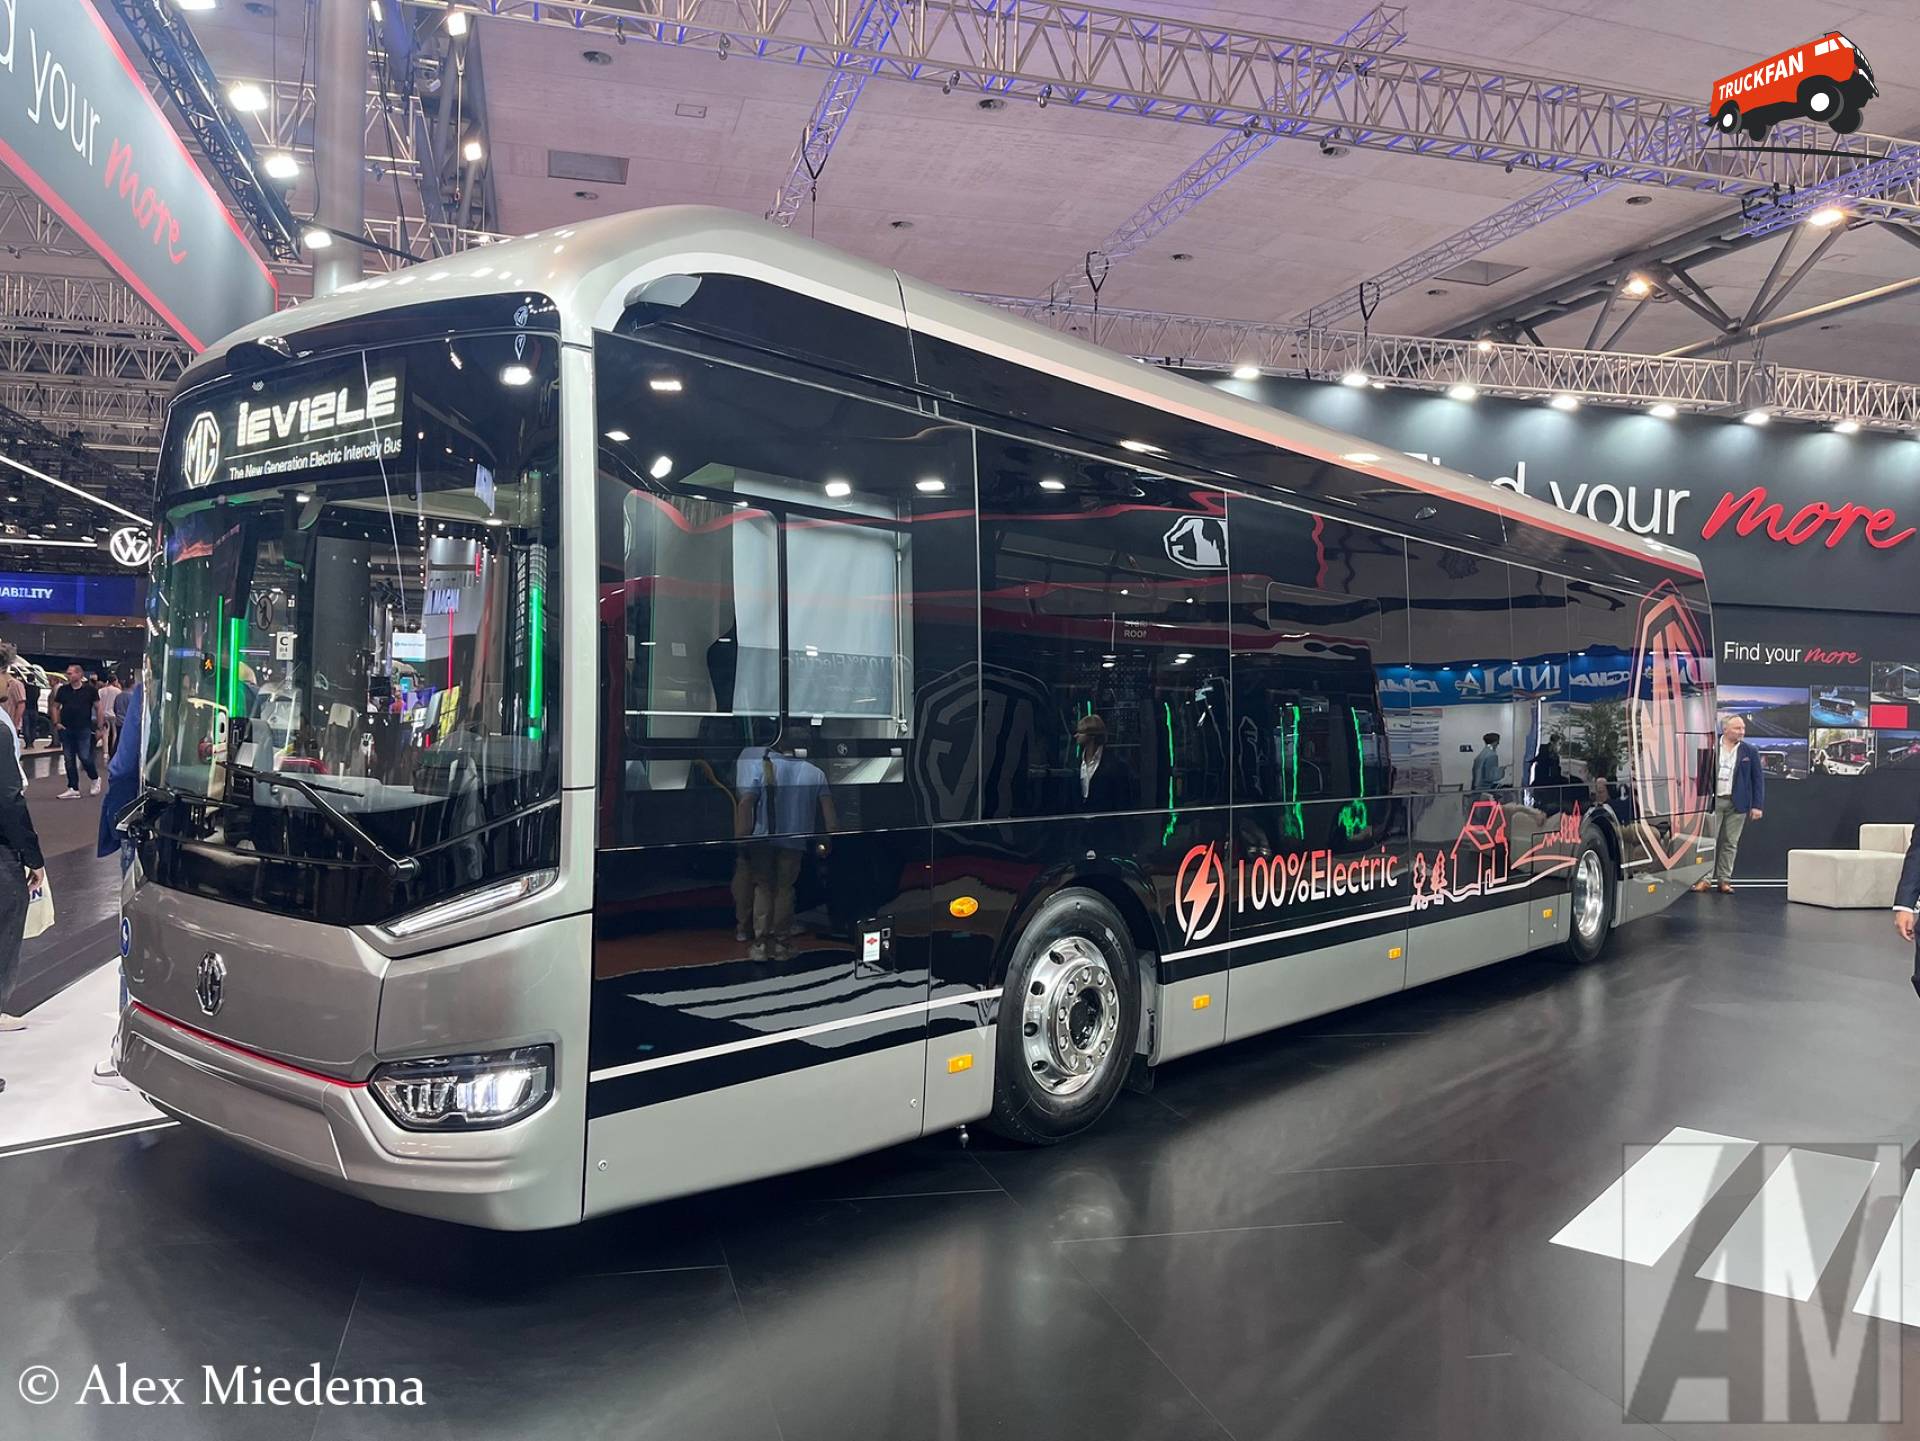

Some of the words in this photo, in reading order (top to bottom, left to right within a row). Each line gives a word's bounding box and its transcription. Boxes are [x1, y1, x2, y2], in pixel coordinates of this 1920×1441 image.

[27, 28, 101, 167] your
[104, 138, 188, 265] more
[186, 416, 219, 487] MG
[229, 467, 244, 480] The
[245, 463, 264, 477] New
[264, 455, 308, 475] Generation
[309, 447, 342, 468] Electric
[343, 440, 382, 460] Intercity
[383, 436, 402, 454] Bus
[1549, 481, 1691, 535] your
[1701, 486, 1917, 549] more
[0, 586, 53, 599] ABILITY
[1723, 641, 1760, 662] Find
[1765, 647, 1802, 665] your
[1804, 647, 1863, 664] more
[1237, 845, 1398, 914] 100%Electric
